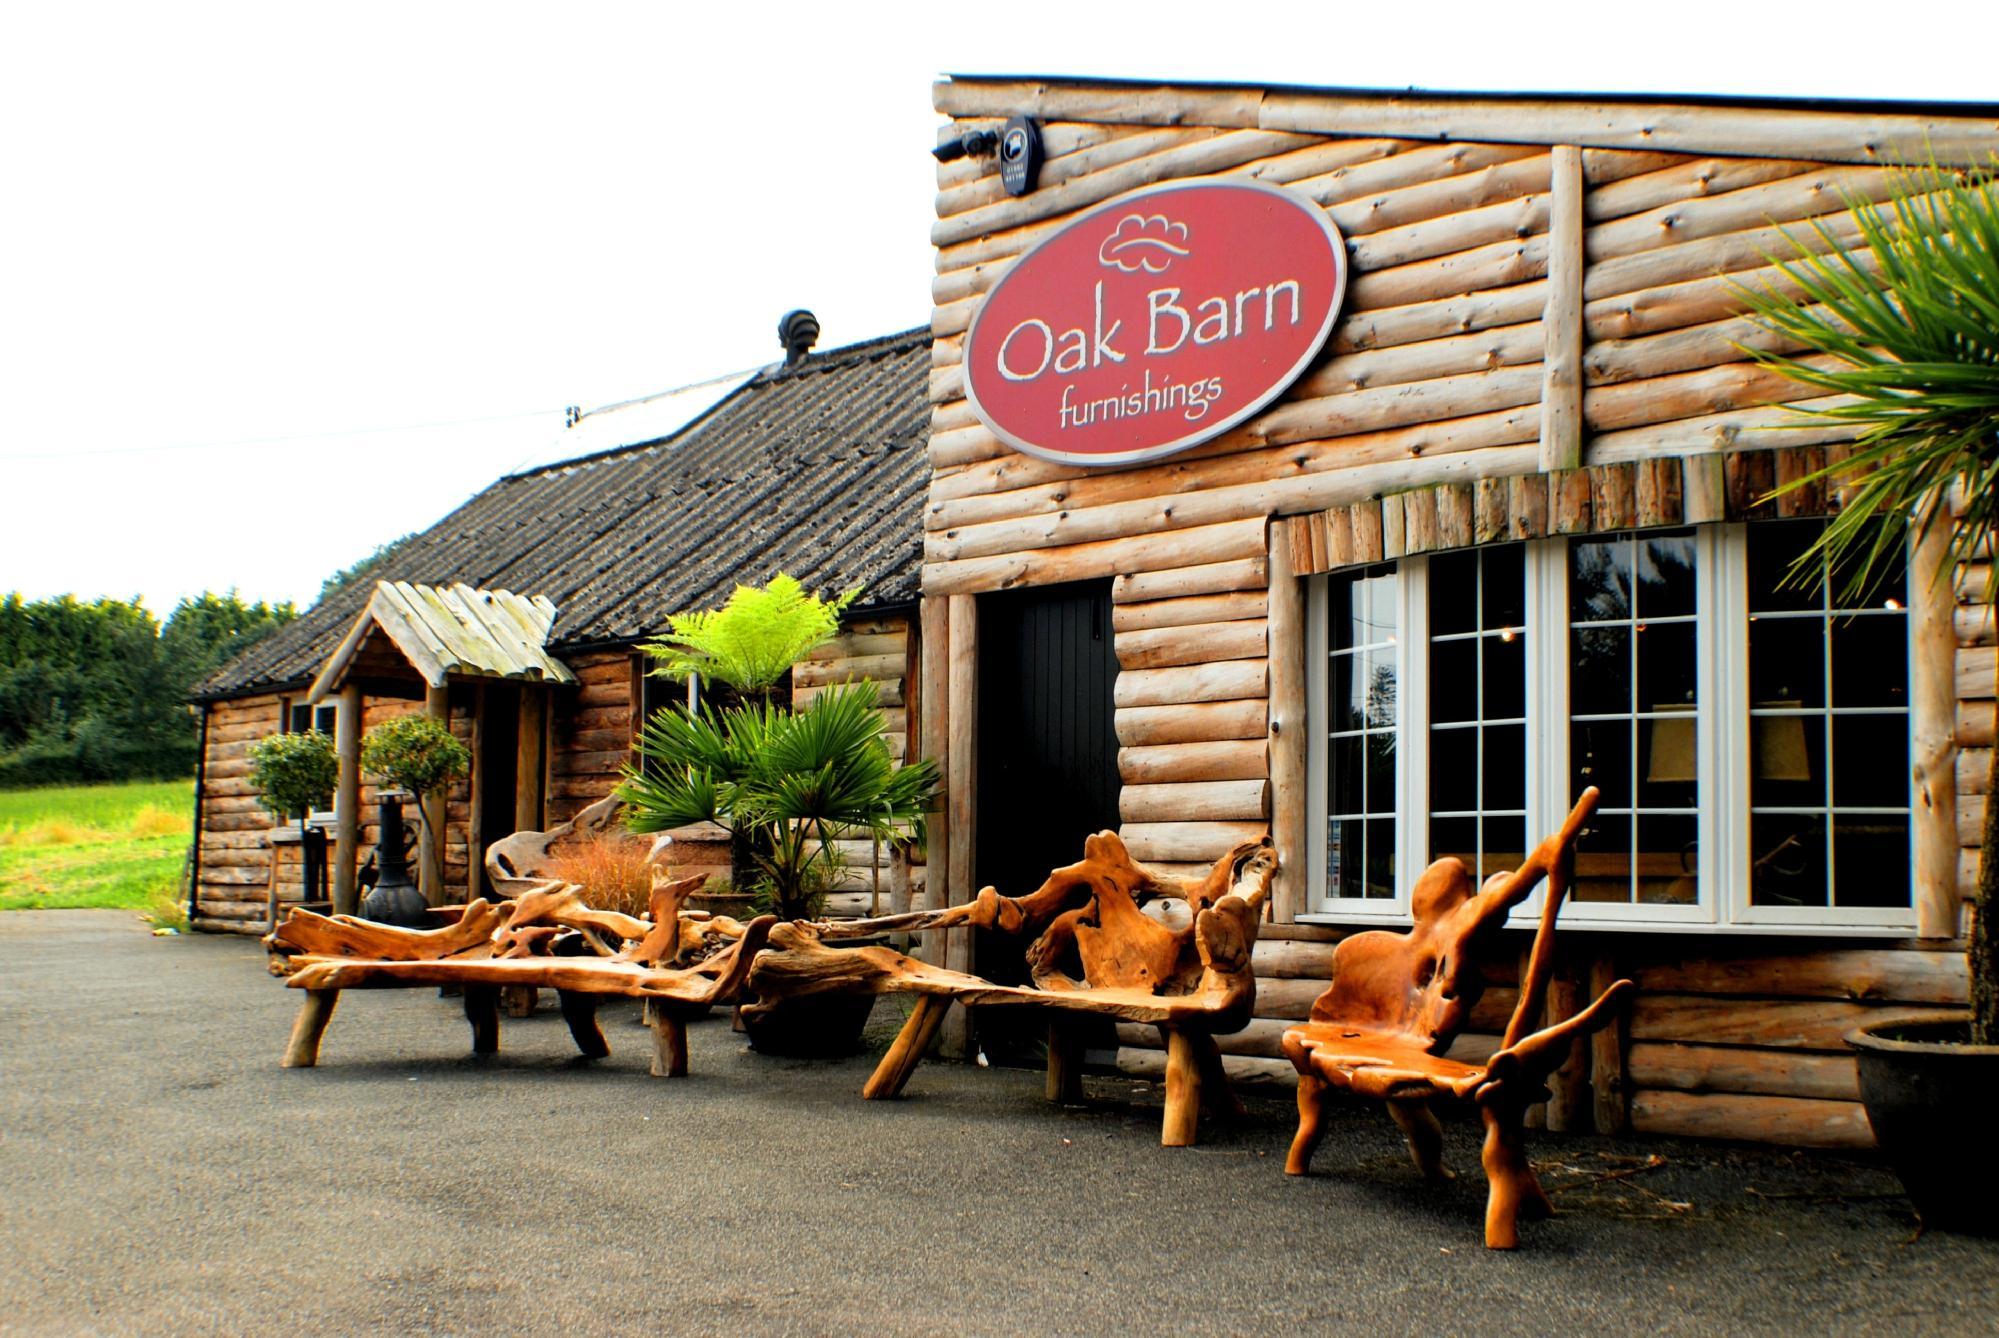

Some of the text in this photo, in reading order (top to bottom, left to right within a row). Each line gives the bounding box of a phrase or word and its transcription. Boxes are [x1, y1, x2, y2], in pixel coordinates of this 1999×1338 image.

[997, 280, 1299, 380] Oak Barn
[1060, 370, 1222, 428] furnishings
